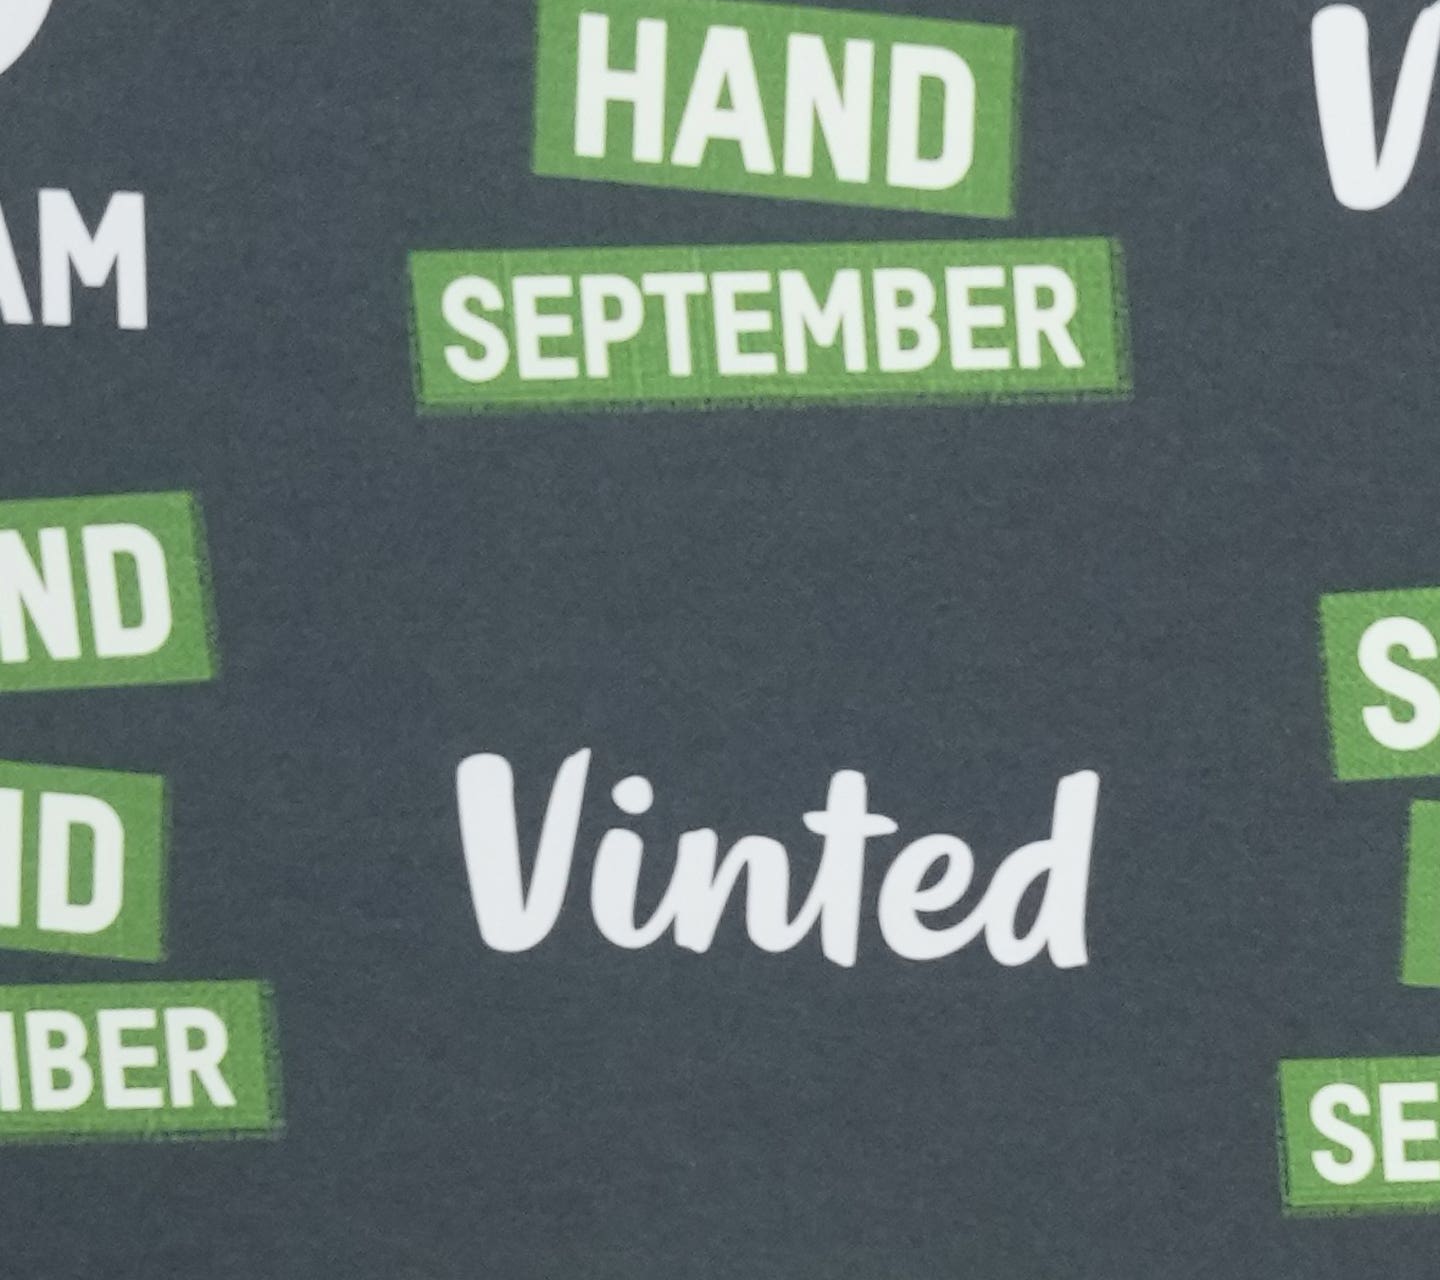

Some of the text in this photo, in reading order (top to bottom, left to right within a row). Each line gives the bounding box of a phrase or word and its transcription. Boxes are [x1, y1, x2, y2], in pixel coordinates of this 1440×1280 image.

[574, 11, 975, 190] HAND
[441, 263, 1083, 382] SEPTEMBER
[456, 748, 1100, 968] Vinted
